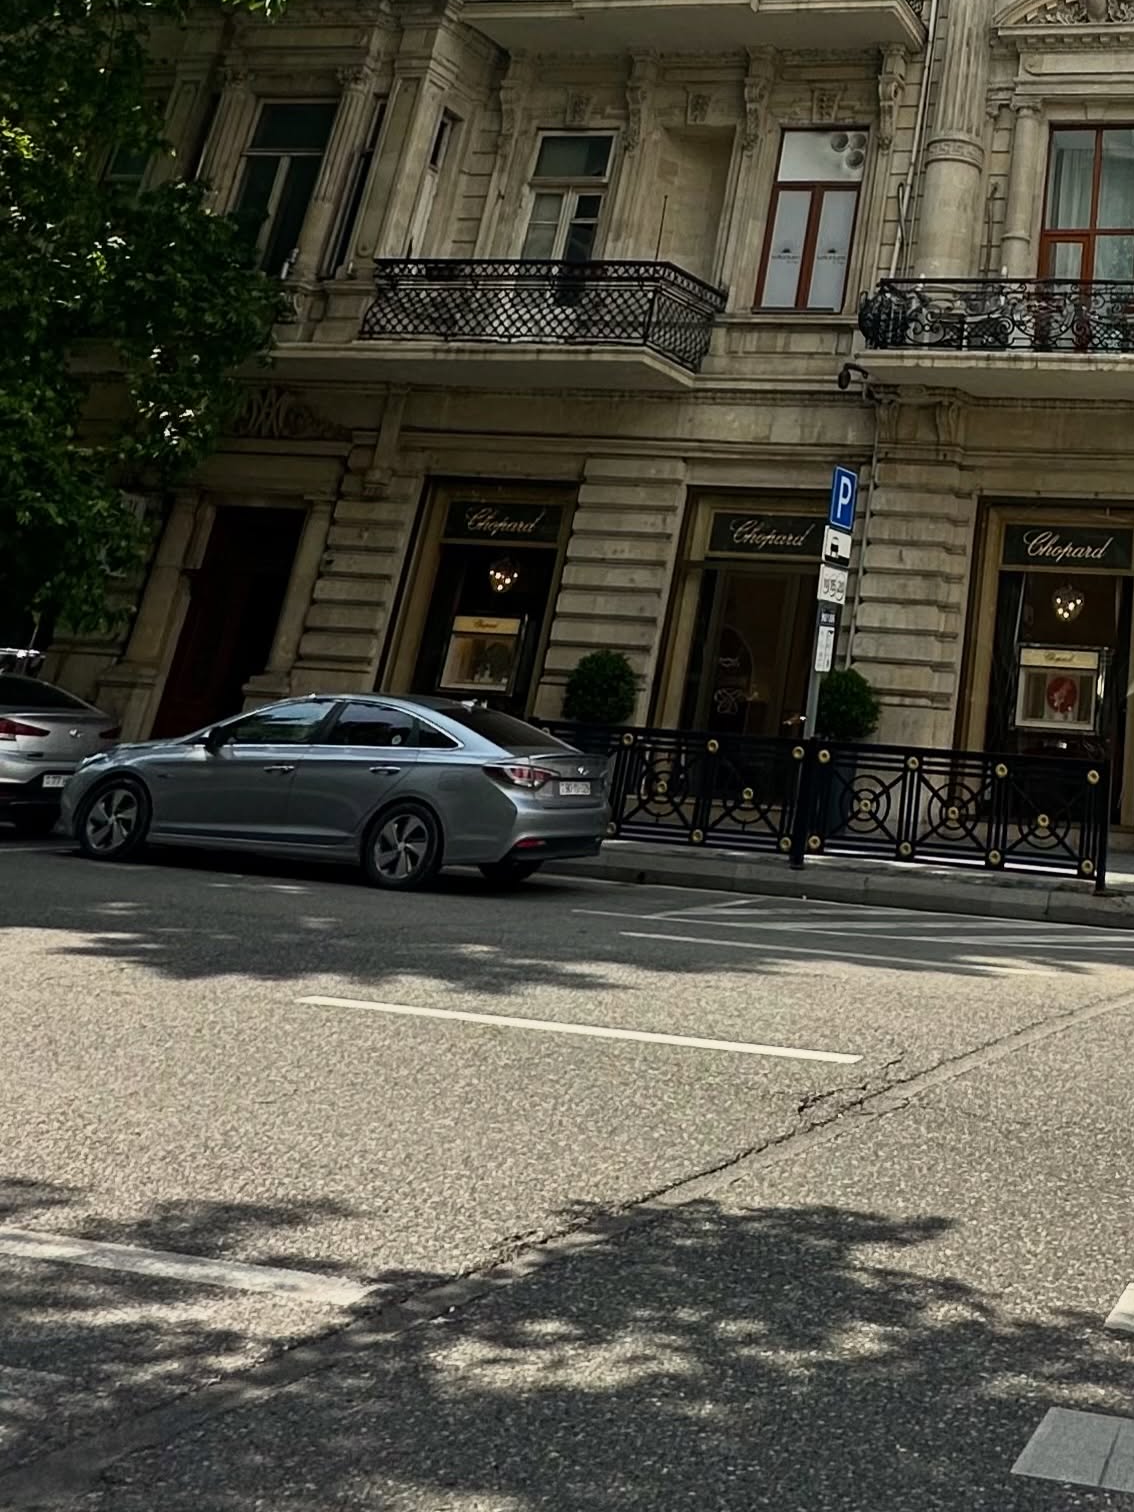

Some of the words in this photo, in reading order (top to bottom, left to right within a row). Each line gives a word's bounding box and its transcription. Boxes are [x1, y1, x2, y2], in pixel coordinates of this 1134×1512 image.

[837, 476, 852, 519] P
[465, 506, 546, 537] Chopard
[730, 519, 816, 549] Chopard
[1023, 529, 1114, 563] Chopard
